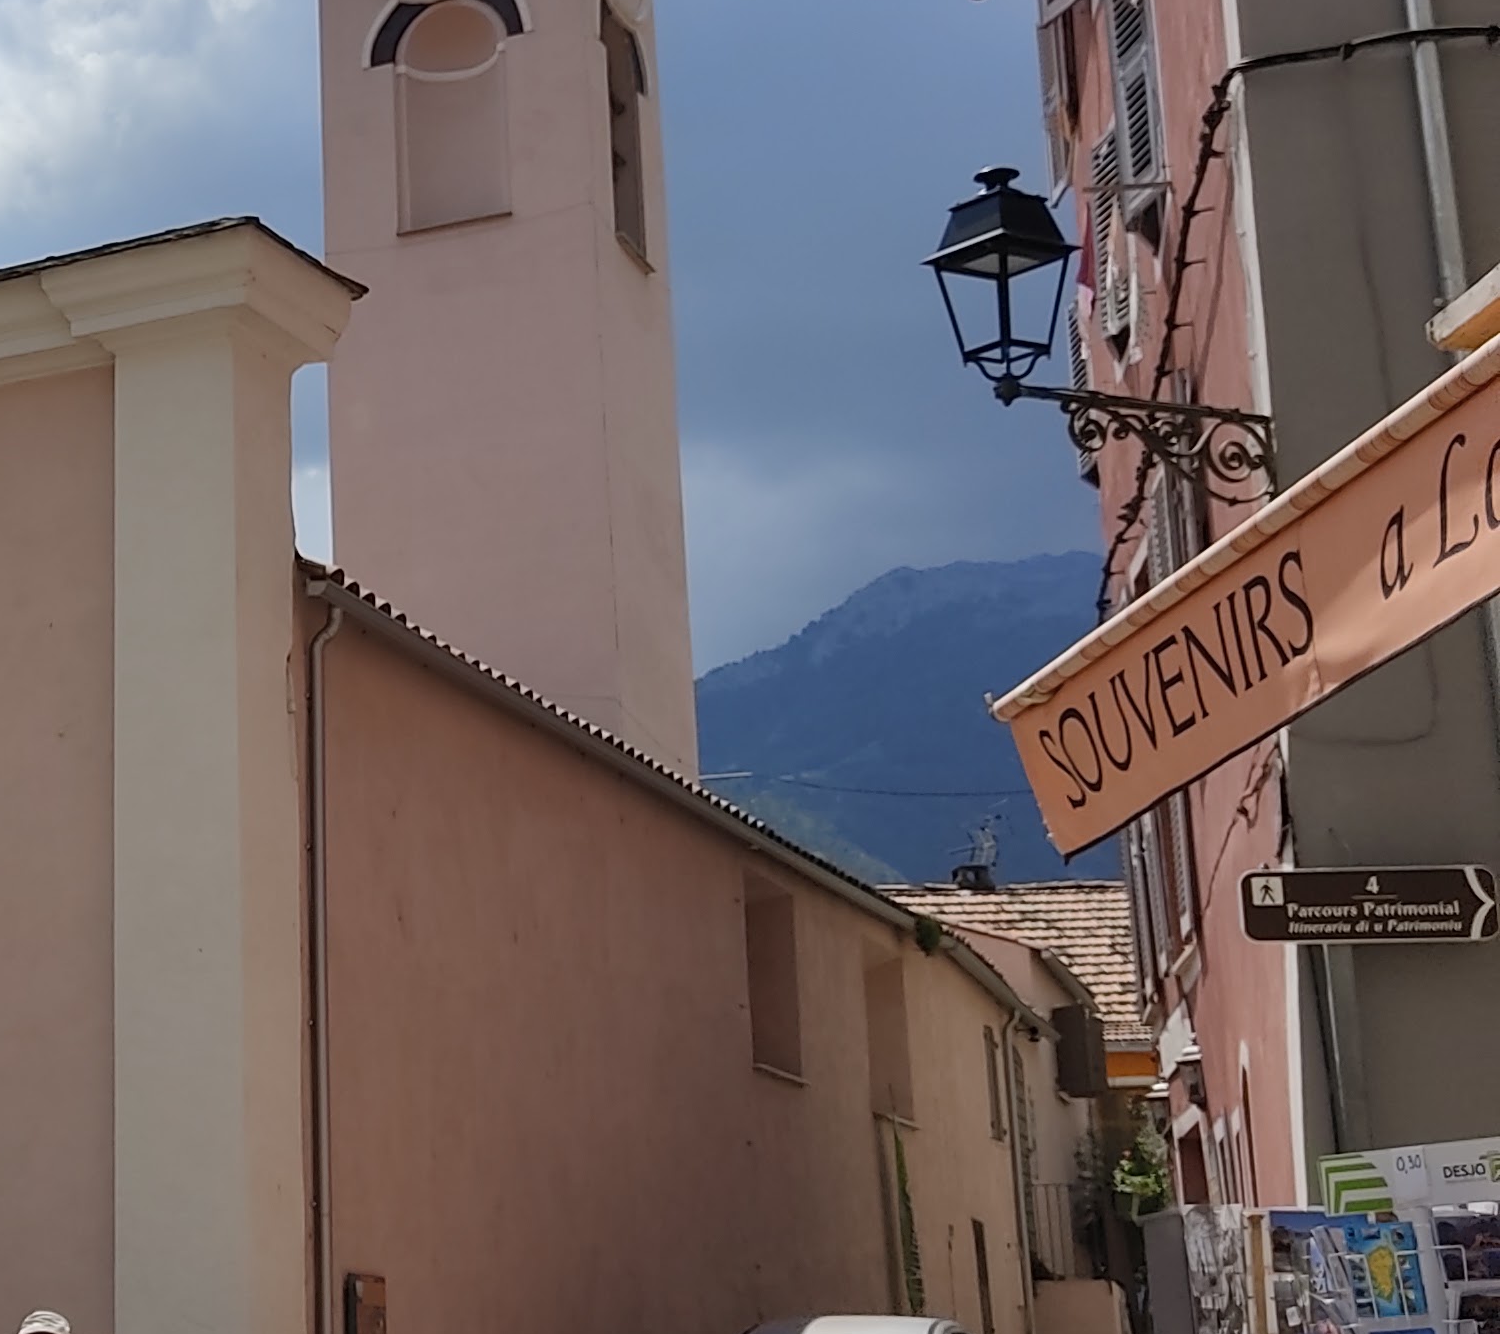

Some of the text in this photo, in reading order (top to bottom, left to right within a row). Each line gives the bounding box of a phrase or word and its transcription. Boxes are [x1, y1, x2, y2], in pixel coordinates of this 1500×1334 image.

[1038, 549, 1314, 809] SOUVENIRS
[1380, 504, 1414, 600] a
[1364, 875, 1381, 895] 4
[1286, 900, 1460, 918] Parcours Patrimonial
[1355, 920, 1370, 933] di
[1387, 919, 1463, 934] Patrimoniu
[1396, 1154, 1422, 1174] 0,30
